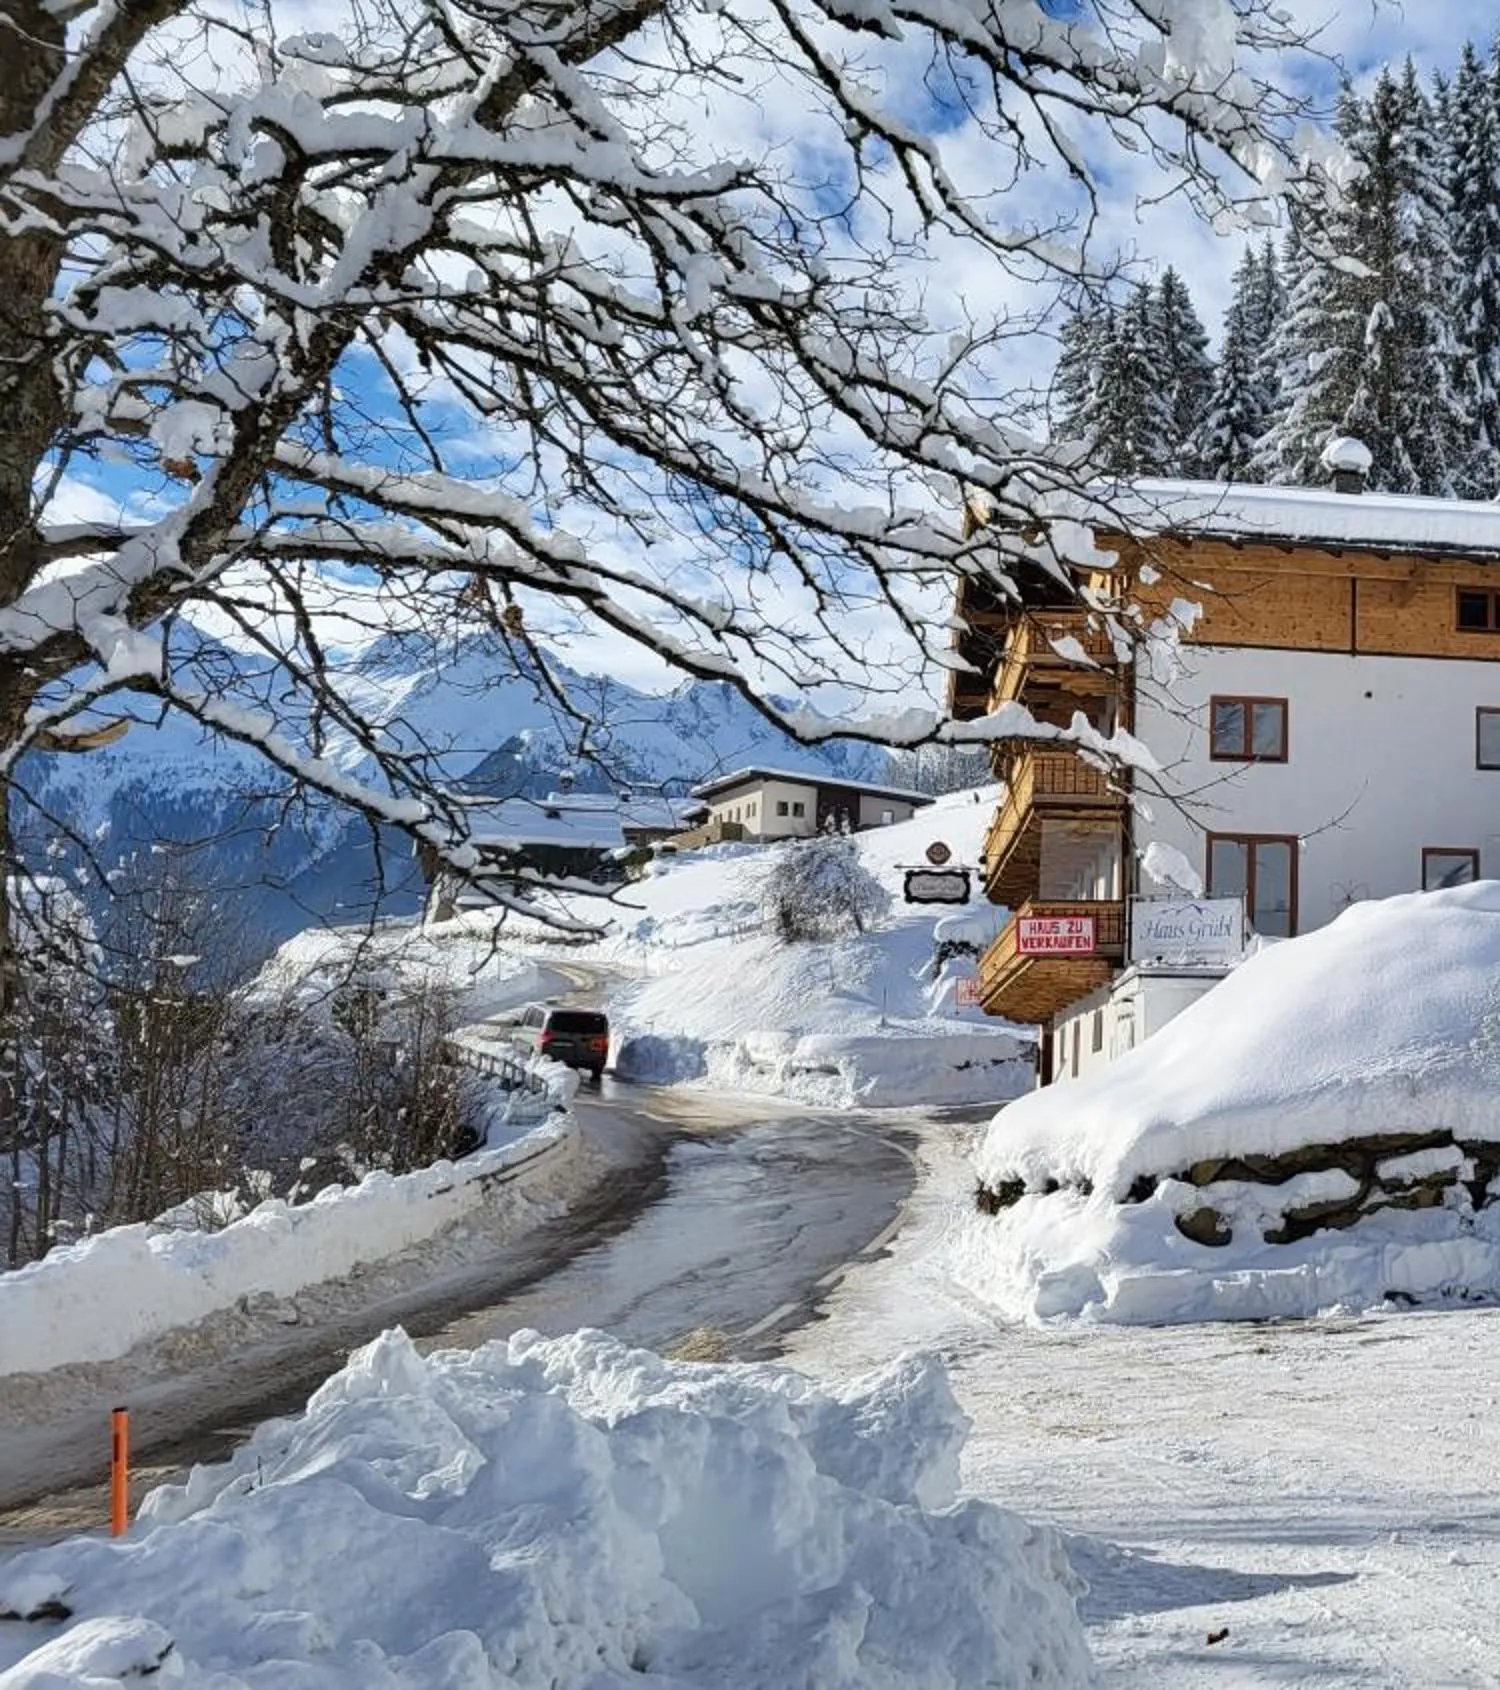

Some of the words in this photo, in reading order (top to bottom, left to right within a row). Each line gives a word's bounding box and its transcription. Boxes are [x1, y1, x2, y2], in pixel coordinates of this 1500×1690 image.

[1029, 921, 1061, 934] HAUS
[1067, 920, 1083, 933] ZU
[1139, 919, 1185, 940] Haus
[1021, 935, 1091, 949] VERKAUFEN
